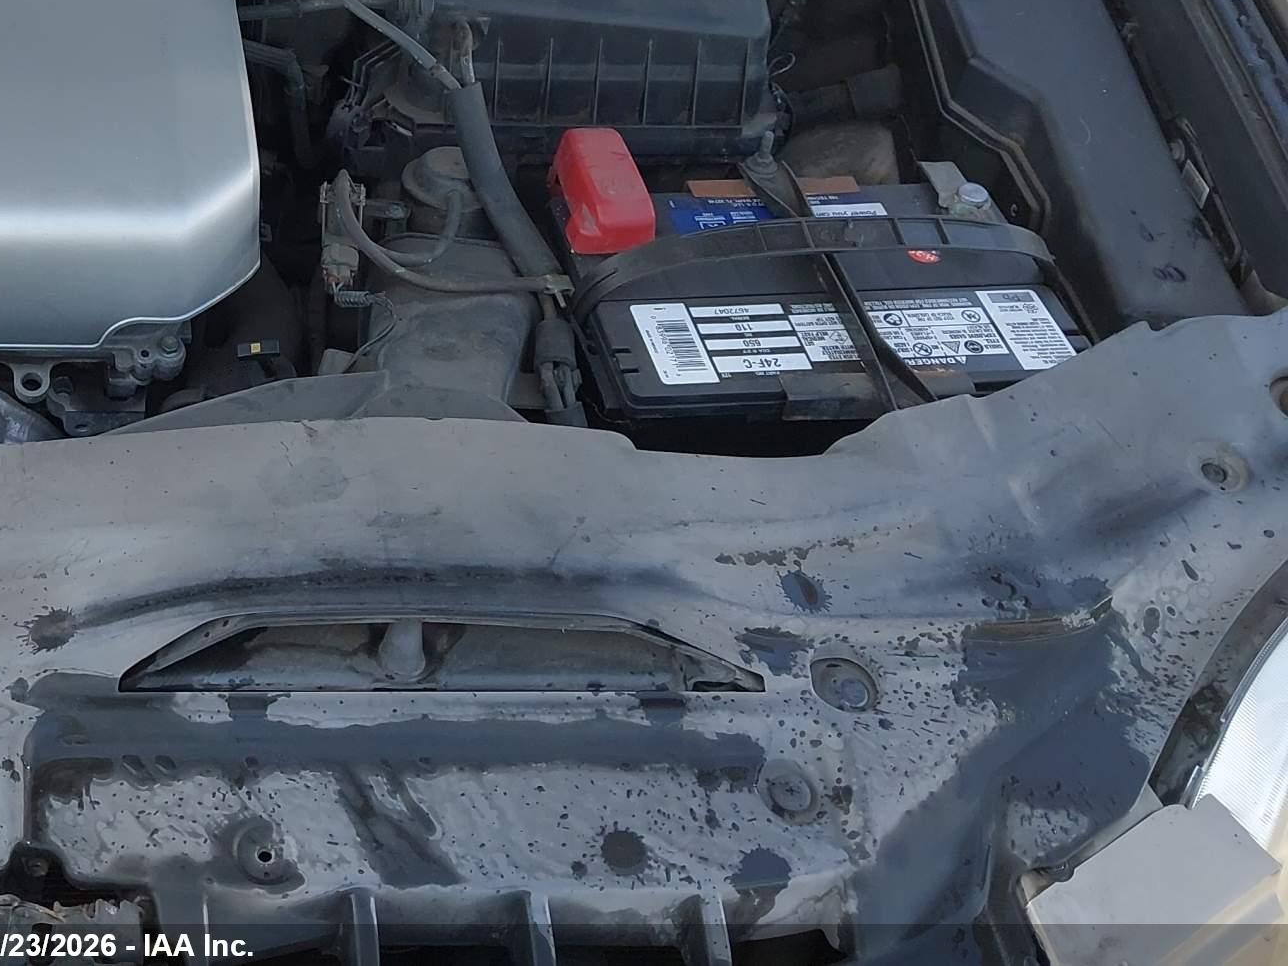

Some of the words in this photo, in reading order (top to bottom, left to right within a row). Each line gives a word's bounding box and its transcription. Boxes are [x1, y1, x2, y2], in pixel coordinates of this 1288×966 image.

[734, 323, 754, 332] 110
[742, 338, 762, 348] 650
[742, 357, 783, 369] 24F-C
